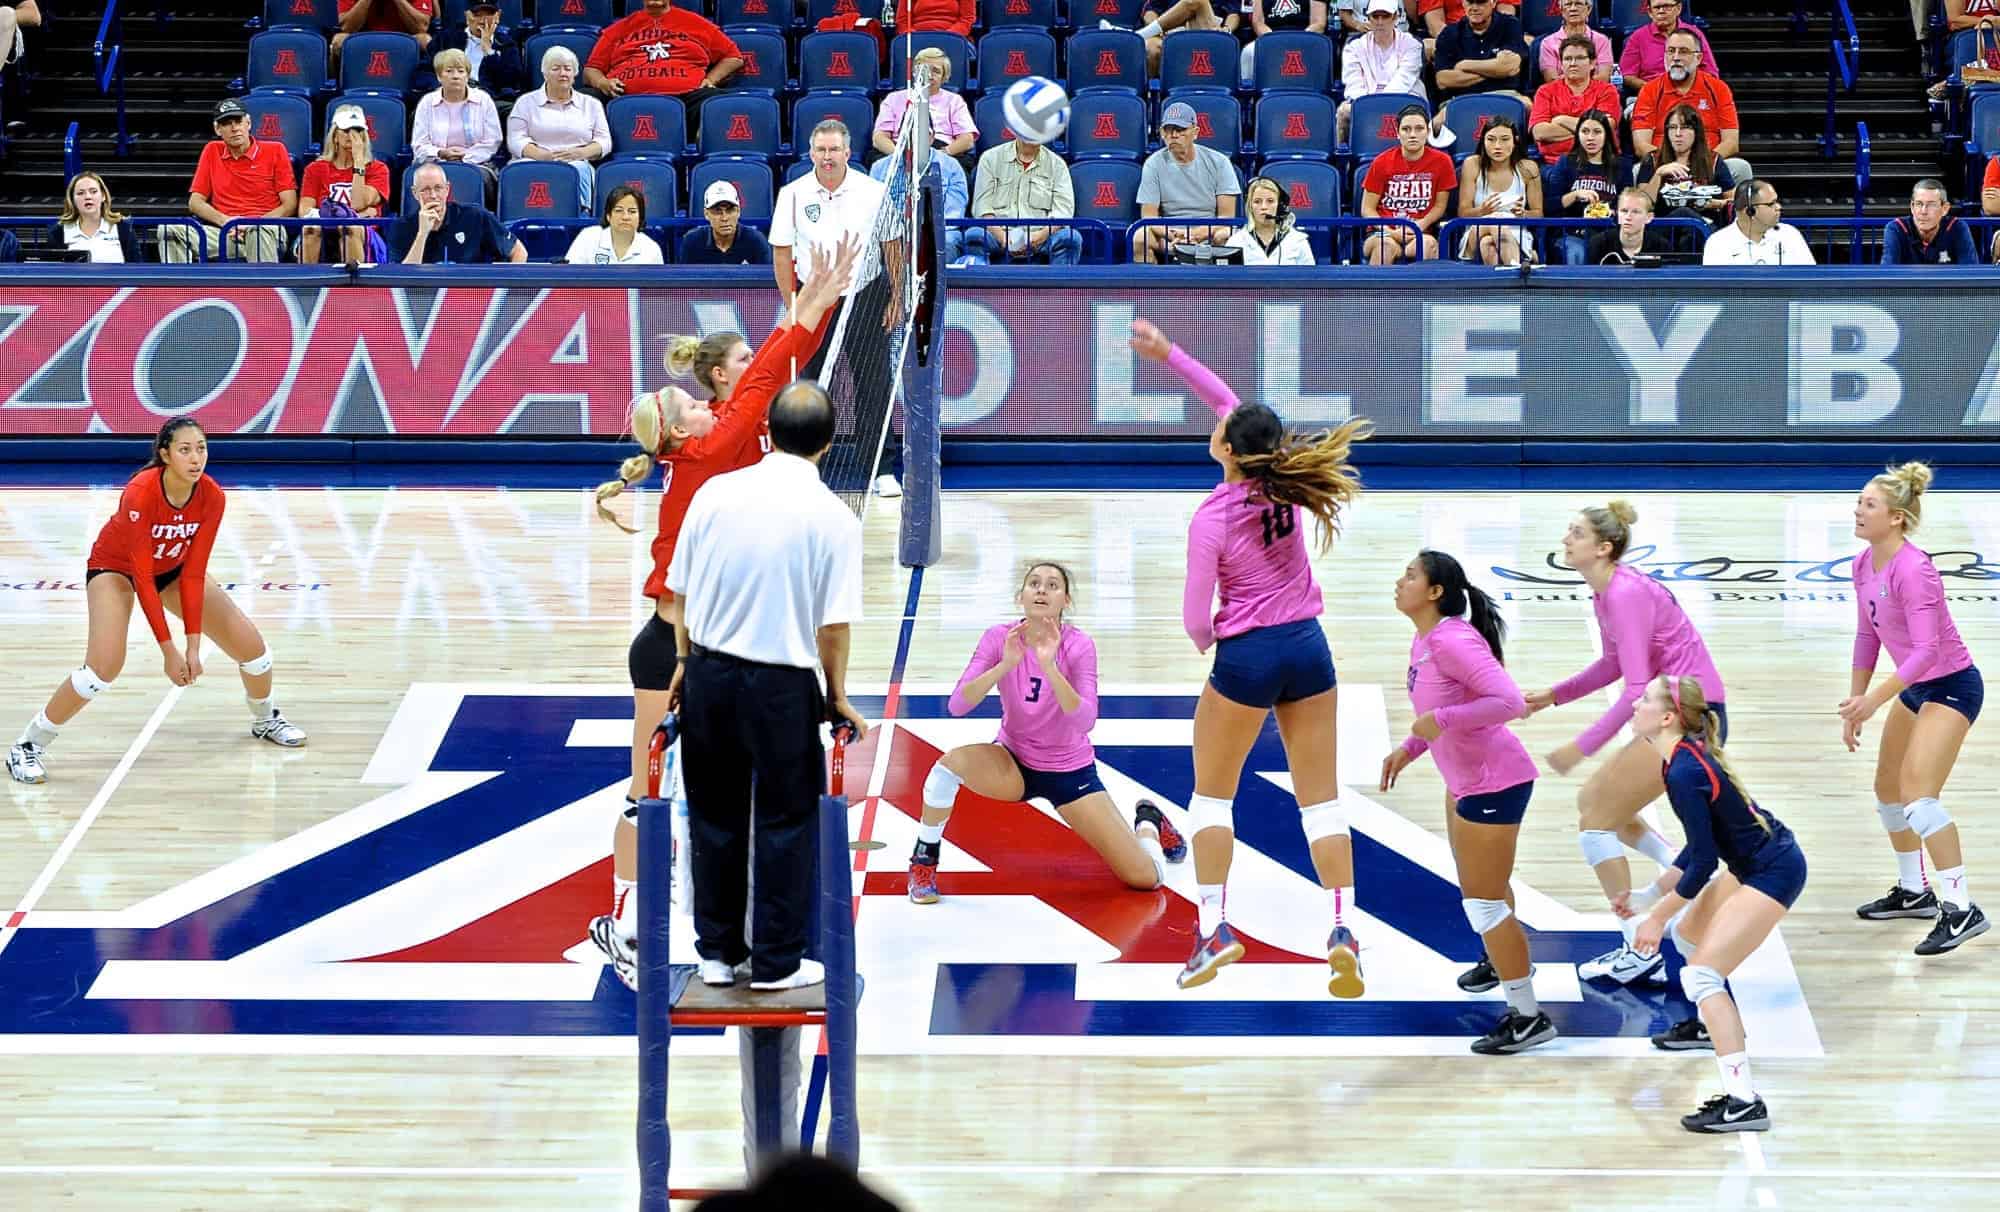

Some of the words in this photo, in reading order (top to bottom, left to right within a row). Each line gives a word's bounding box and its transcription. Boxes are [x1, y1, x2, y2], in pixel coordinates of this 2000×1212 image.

[617, 65, 690, 81] OOTBALL
[1388, 180, 1433, 199] BEAR
[151, 522, 200, 540] UTAH
[1024, 676, 1043, 703] 3
